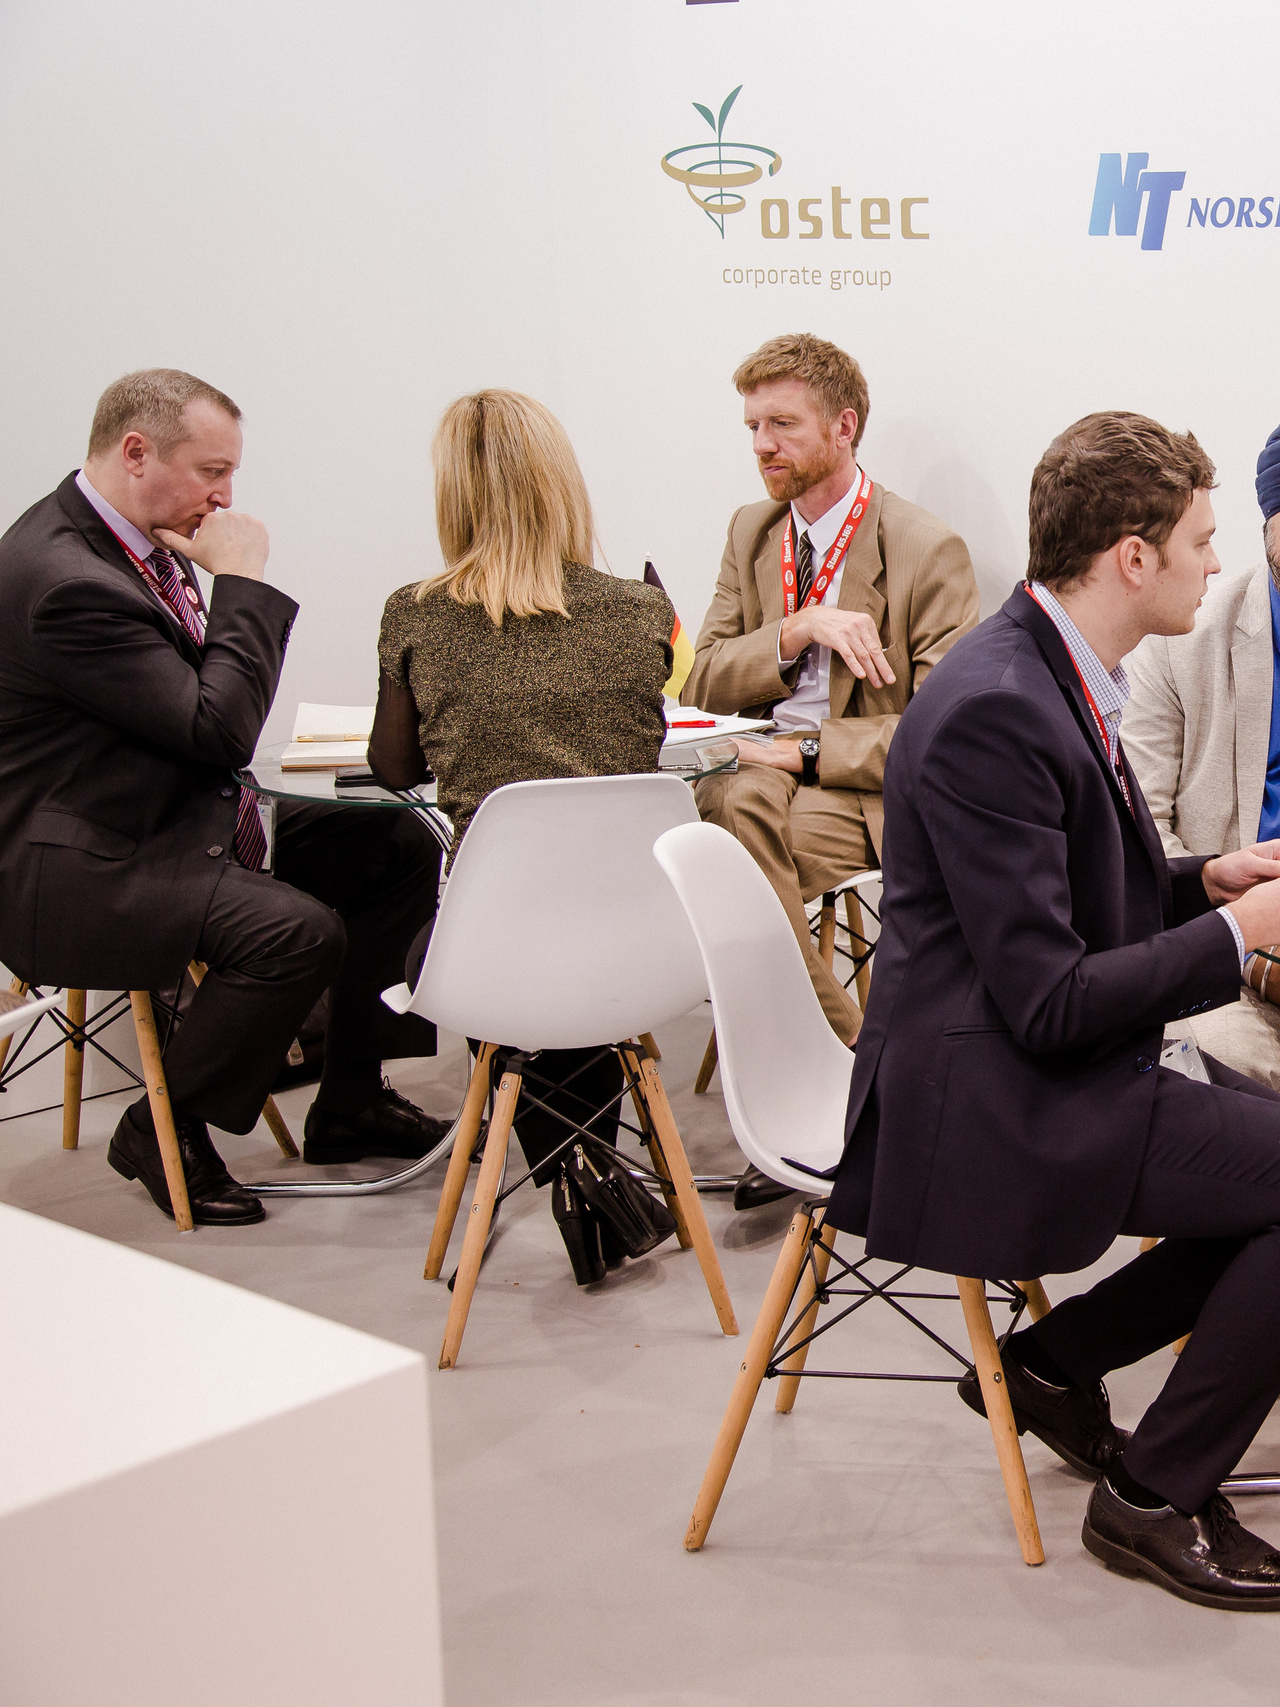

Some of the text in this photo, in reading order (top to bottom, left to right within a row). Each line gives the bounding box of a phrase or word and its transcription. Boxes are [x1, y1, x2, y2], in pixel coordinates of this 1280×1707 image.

[761, 186, 930, 240] ostec
[1088, 152, 1187, 250] NT
[722, 265, 892, 291] corporate group
[784, 541, 792, 563] Stand
[826, 547, 842, 570] Stand
